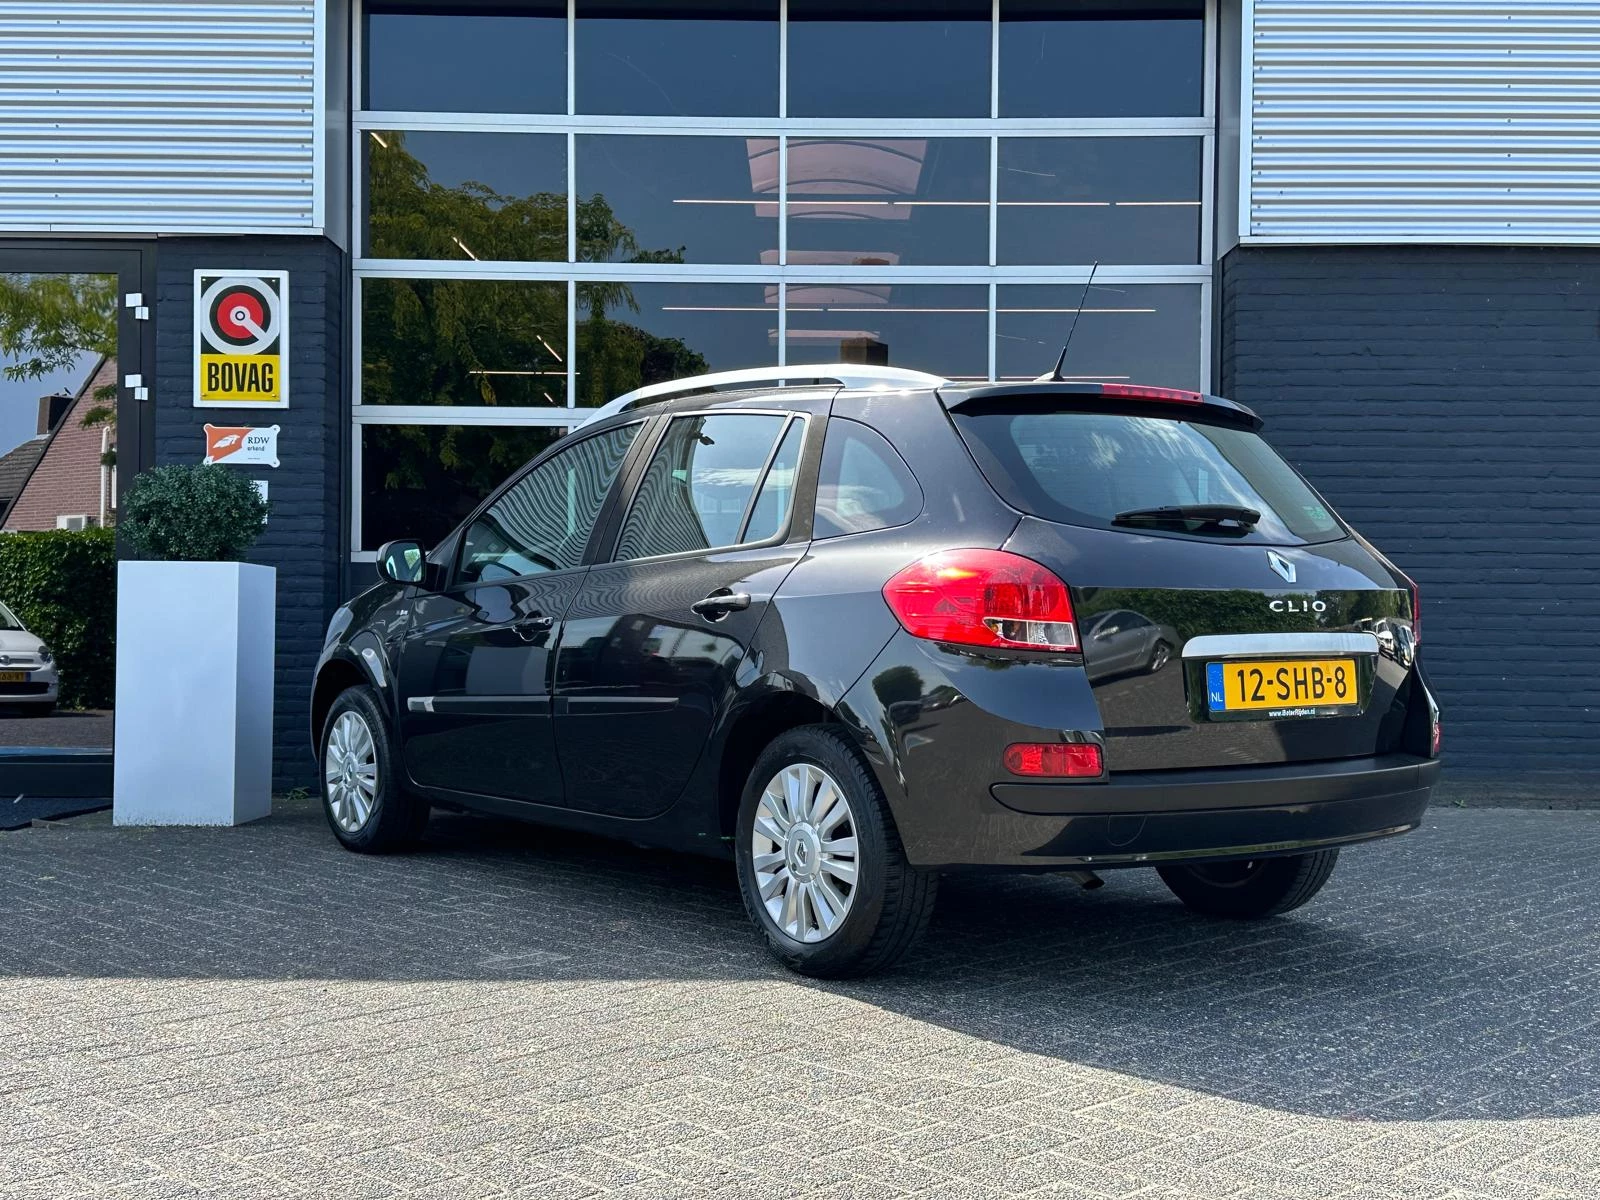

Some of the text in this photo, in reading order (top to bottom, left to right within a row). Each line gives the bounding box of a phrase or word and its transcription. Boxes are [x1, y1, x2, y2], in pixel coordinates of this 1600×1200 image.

[207, 362, 274, 393] BOVAG
[247, 436, 270, 444] RDW
[1269, 600, 1327, 613] CLIO
[1237, 666, 1347, 702] 12-SHB-8
[1211, 692, 1224, 703] NL
